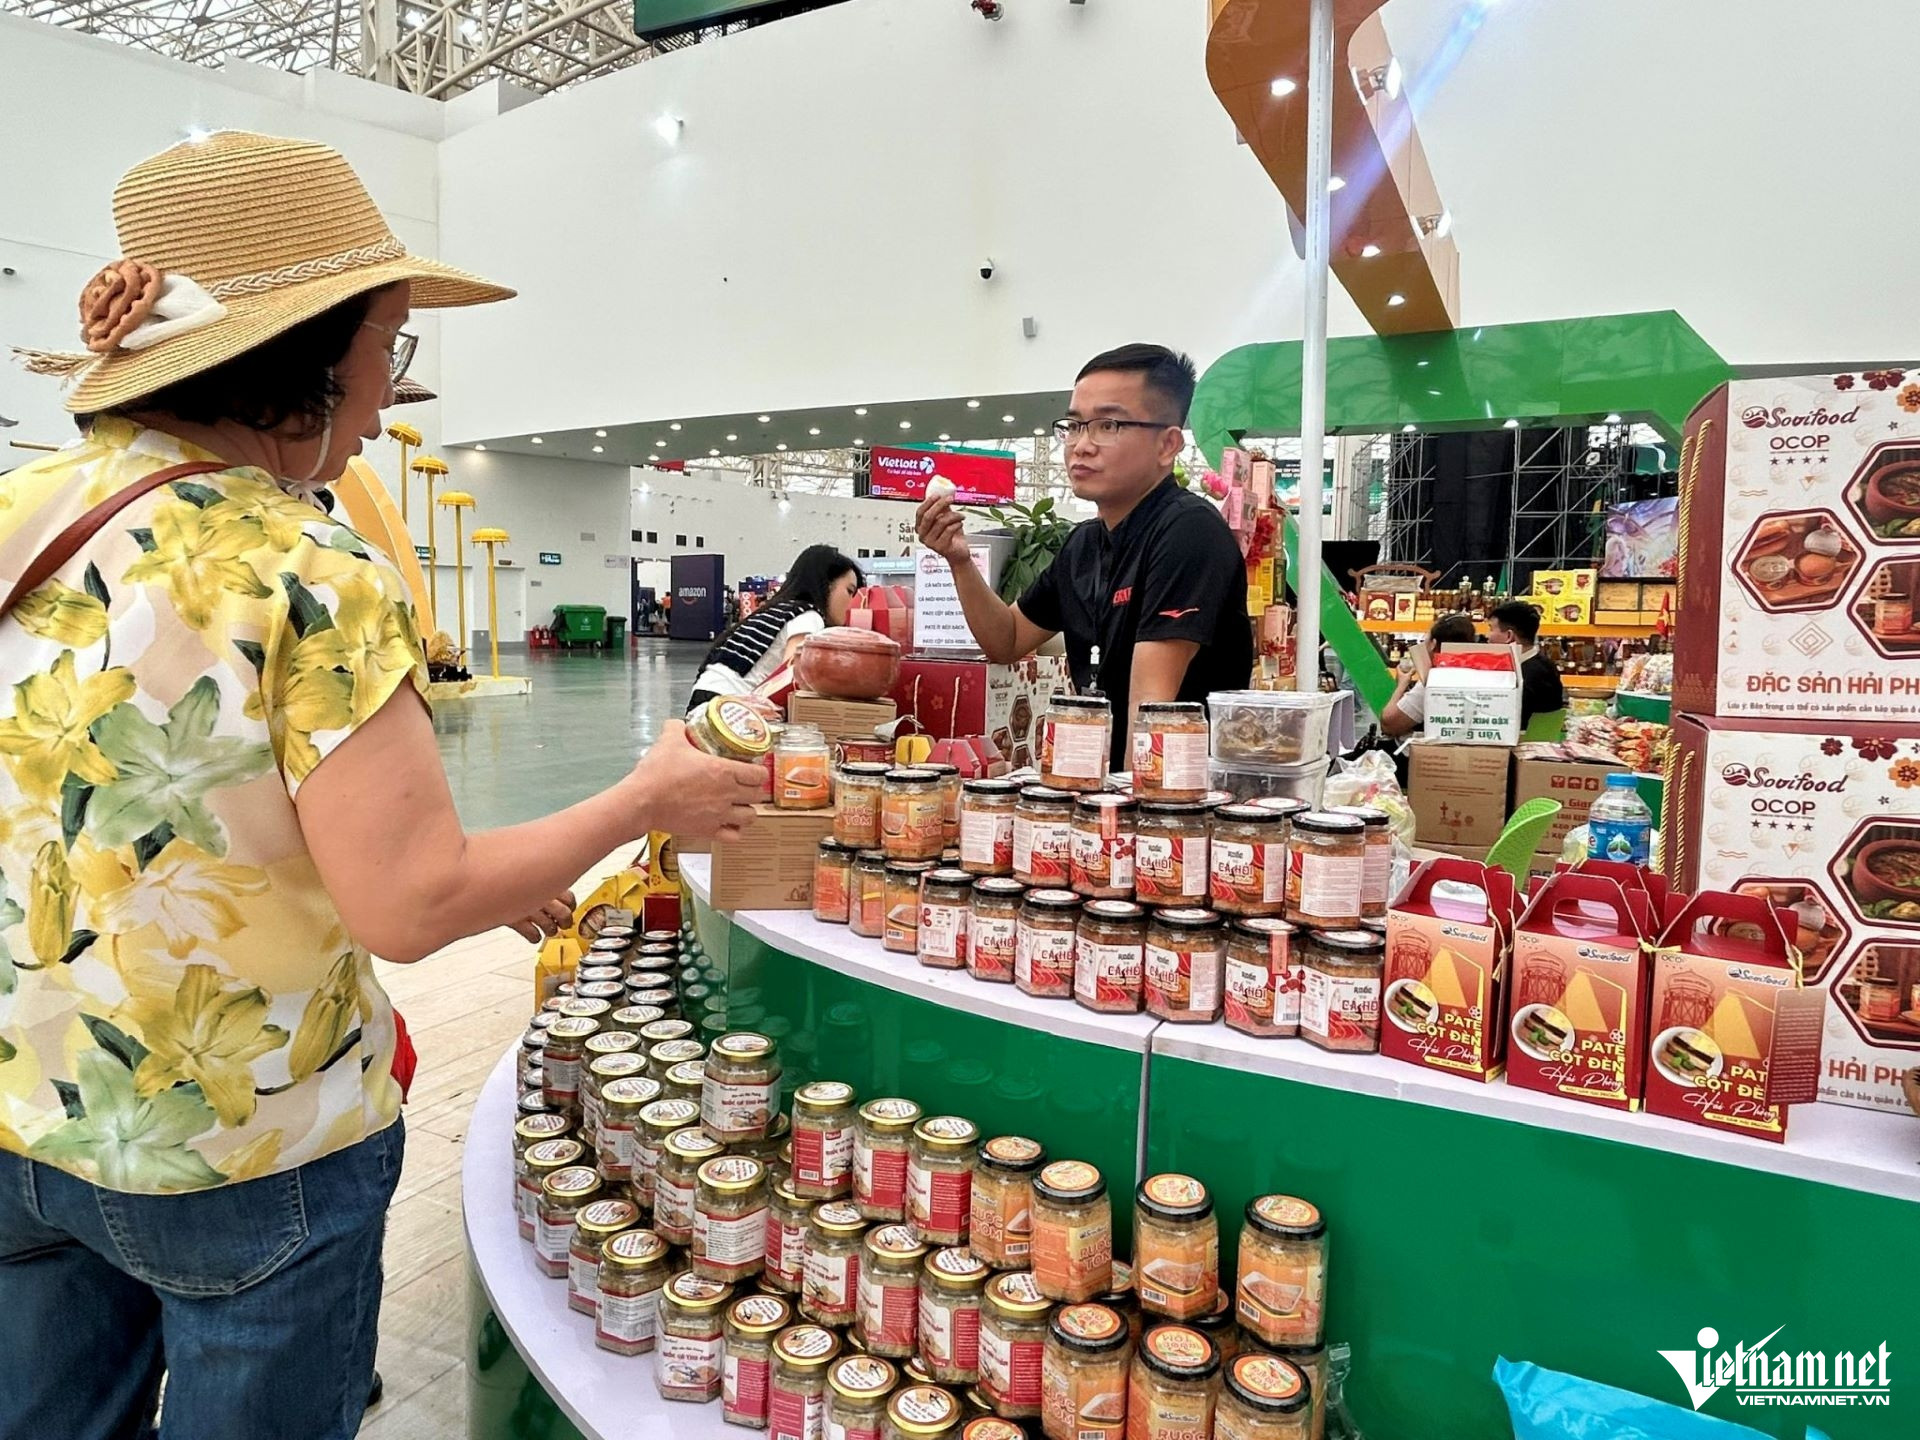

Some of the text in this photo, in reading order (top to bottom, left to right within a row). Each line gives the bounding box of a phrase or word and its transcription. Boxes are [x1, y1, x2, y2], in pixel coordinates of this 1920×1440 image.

[1770, 434, 1830, 450] OCOP
[878, 455, 919, 469] Vietlott
[899, 534, 914, 543] Hall
[678, 587, 706, 598] amazon
[1747, 671, 1920, 696] ĐẶC SẢN HẢI PH
[1751, 798, 1816, 815] OCOP
[1445, 1013, 1482, 1032] PATE
[1416, 1021, 1482, 1047] CỘT ĐÈN
[1581, 1039, 1625, 1056] PATE
[1549, 1049, 1625, 1073] CỘT ĐÈN
[1731, 1065, 1768, 1083] PAT
[1829, 1056, 1906, 1087] HẢI PH
[1694, 1075, 1766, 1100] CỘT ĐÈ
